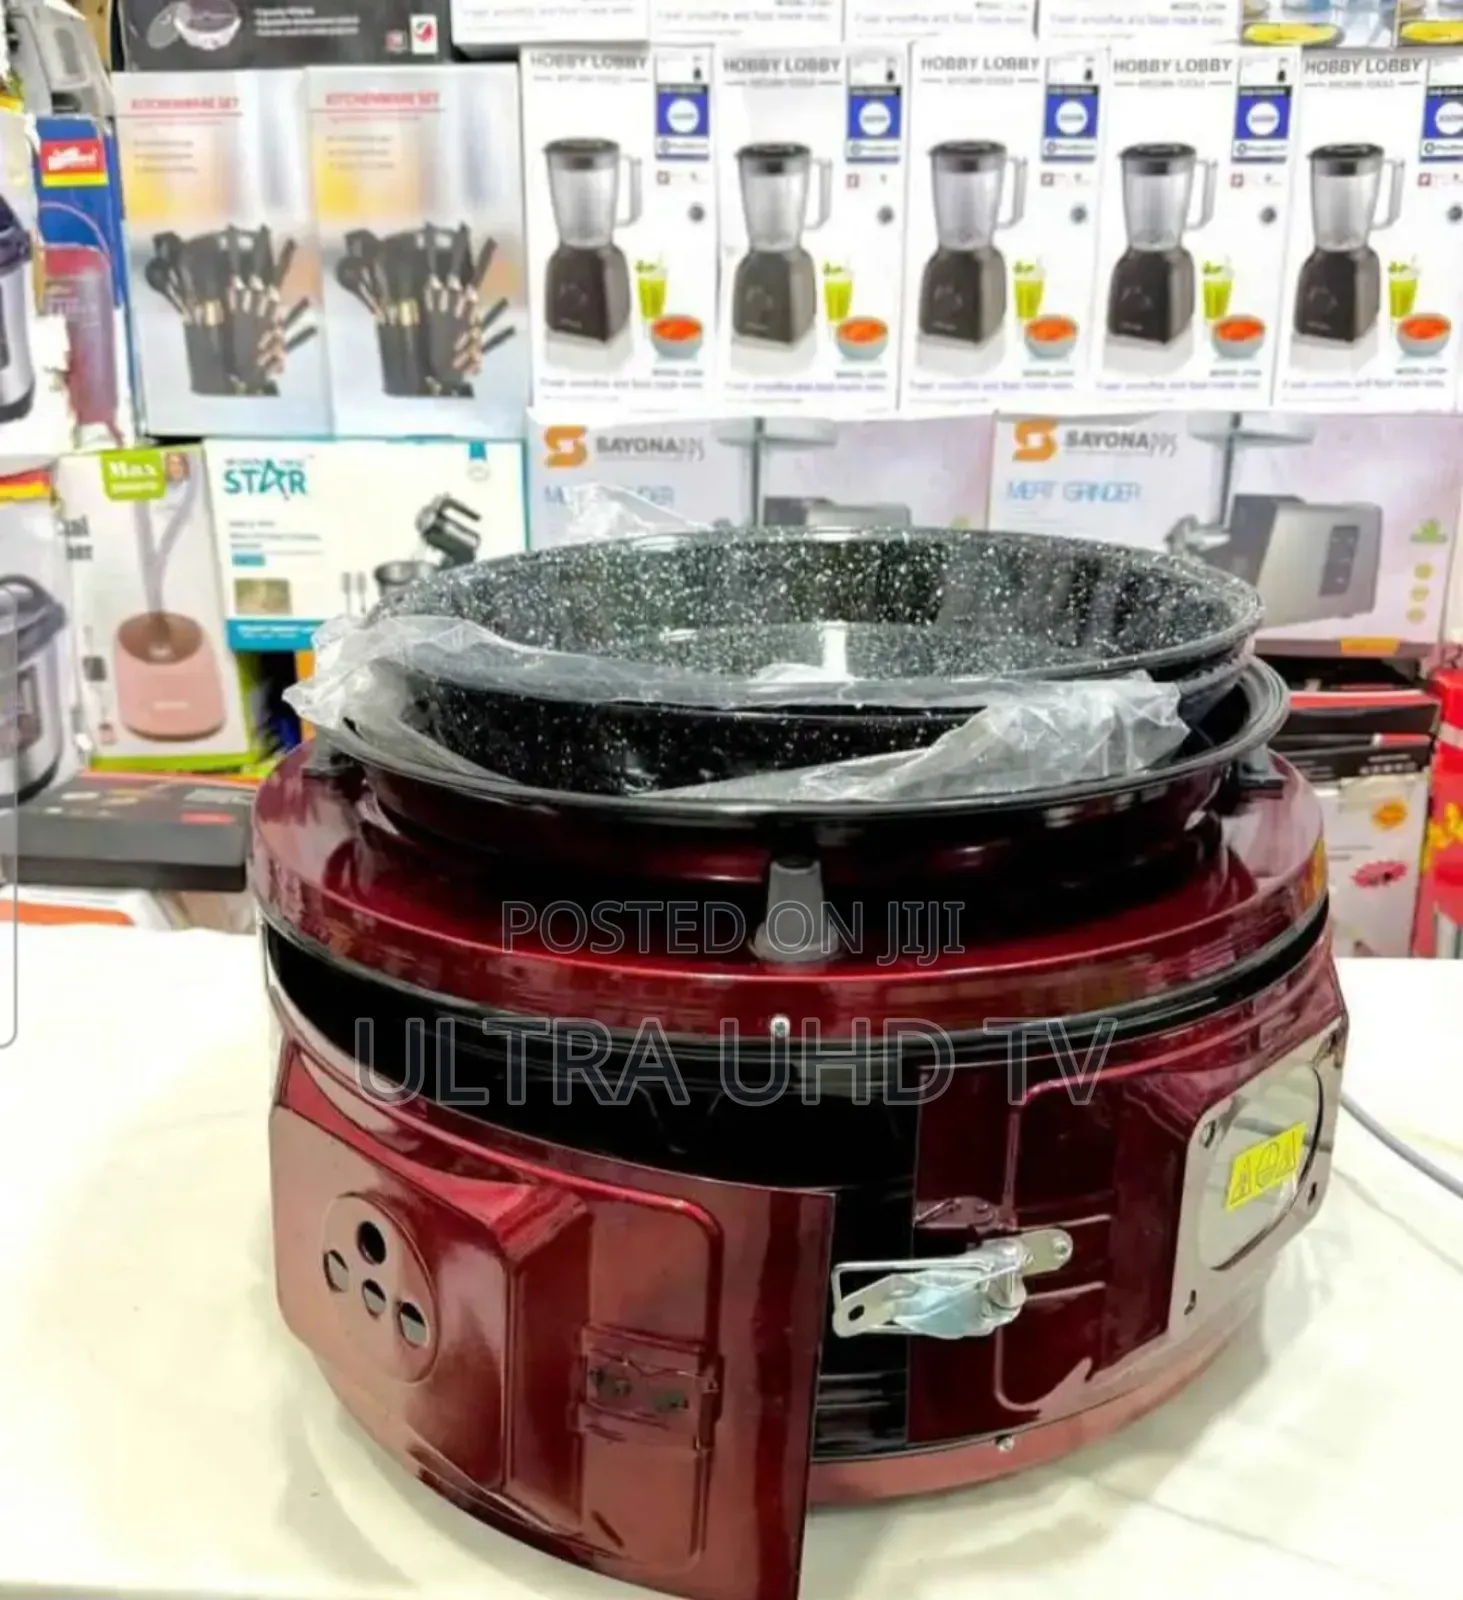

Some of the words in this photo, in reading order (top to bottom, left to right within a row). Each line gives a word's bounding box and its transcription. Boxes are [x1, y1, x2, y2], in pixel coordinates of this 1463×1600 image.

[530, 54, 588, 69] HOBBY
[592, 55, 648, 70] LOBBY
[723, 57, 780, 72] HOBBY
[784, 57, 841, 72] LOBBY
[921, 56, 978, 71] HOBBY
[983, 56, 1039, 71] LOBBY
[1113, 58, 1171, 73] HOBBY
[1175, 58, 1233, 73] LOBBY
[1304, 59, 1364, 74] HOBBY
[1366, 58, 1422, 73] LOBBY
[218, 97, 239, 109] SET
[418, 91, 440, 105] SET
[224, 459, 306, 498] STAR
